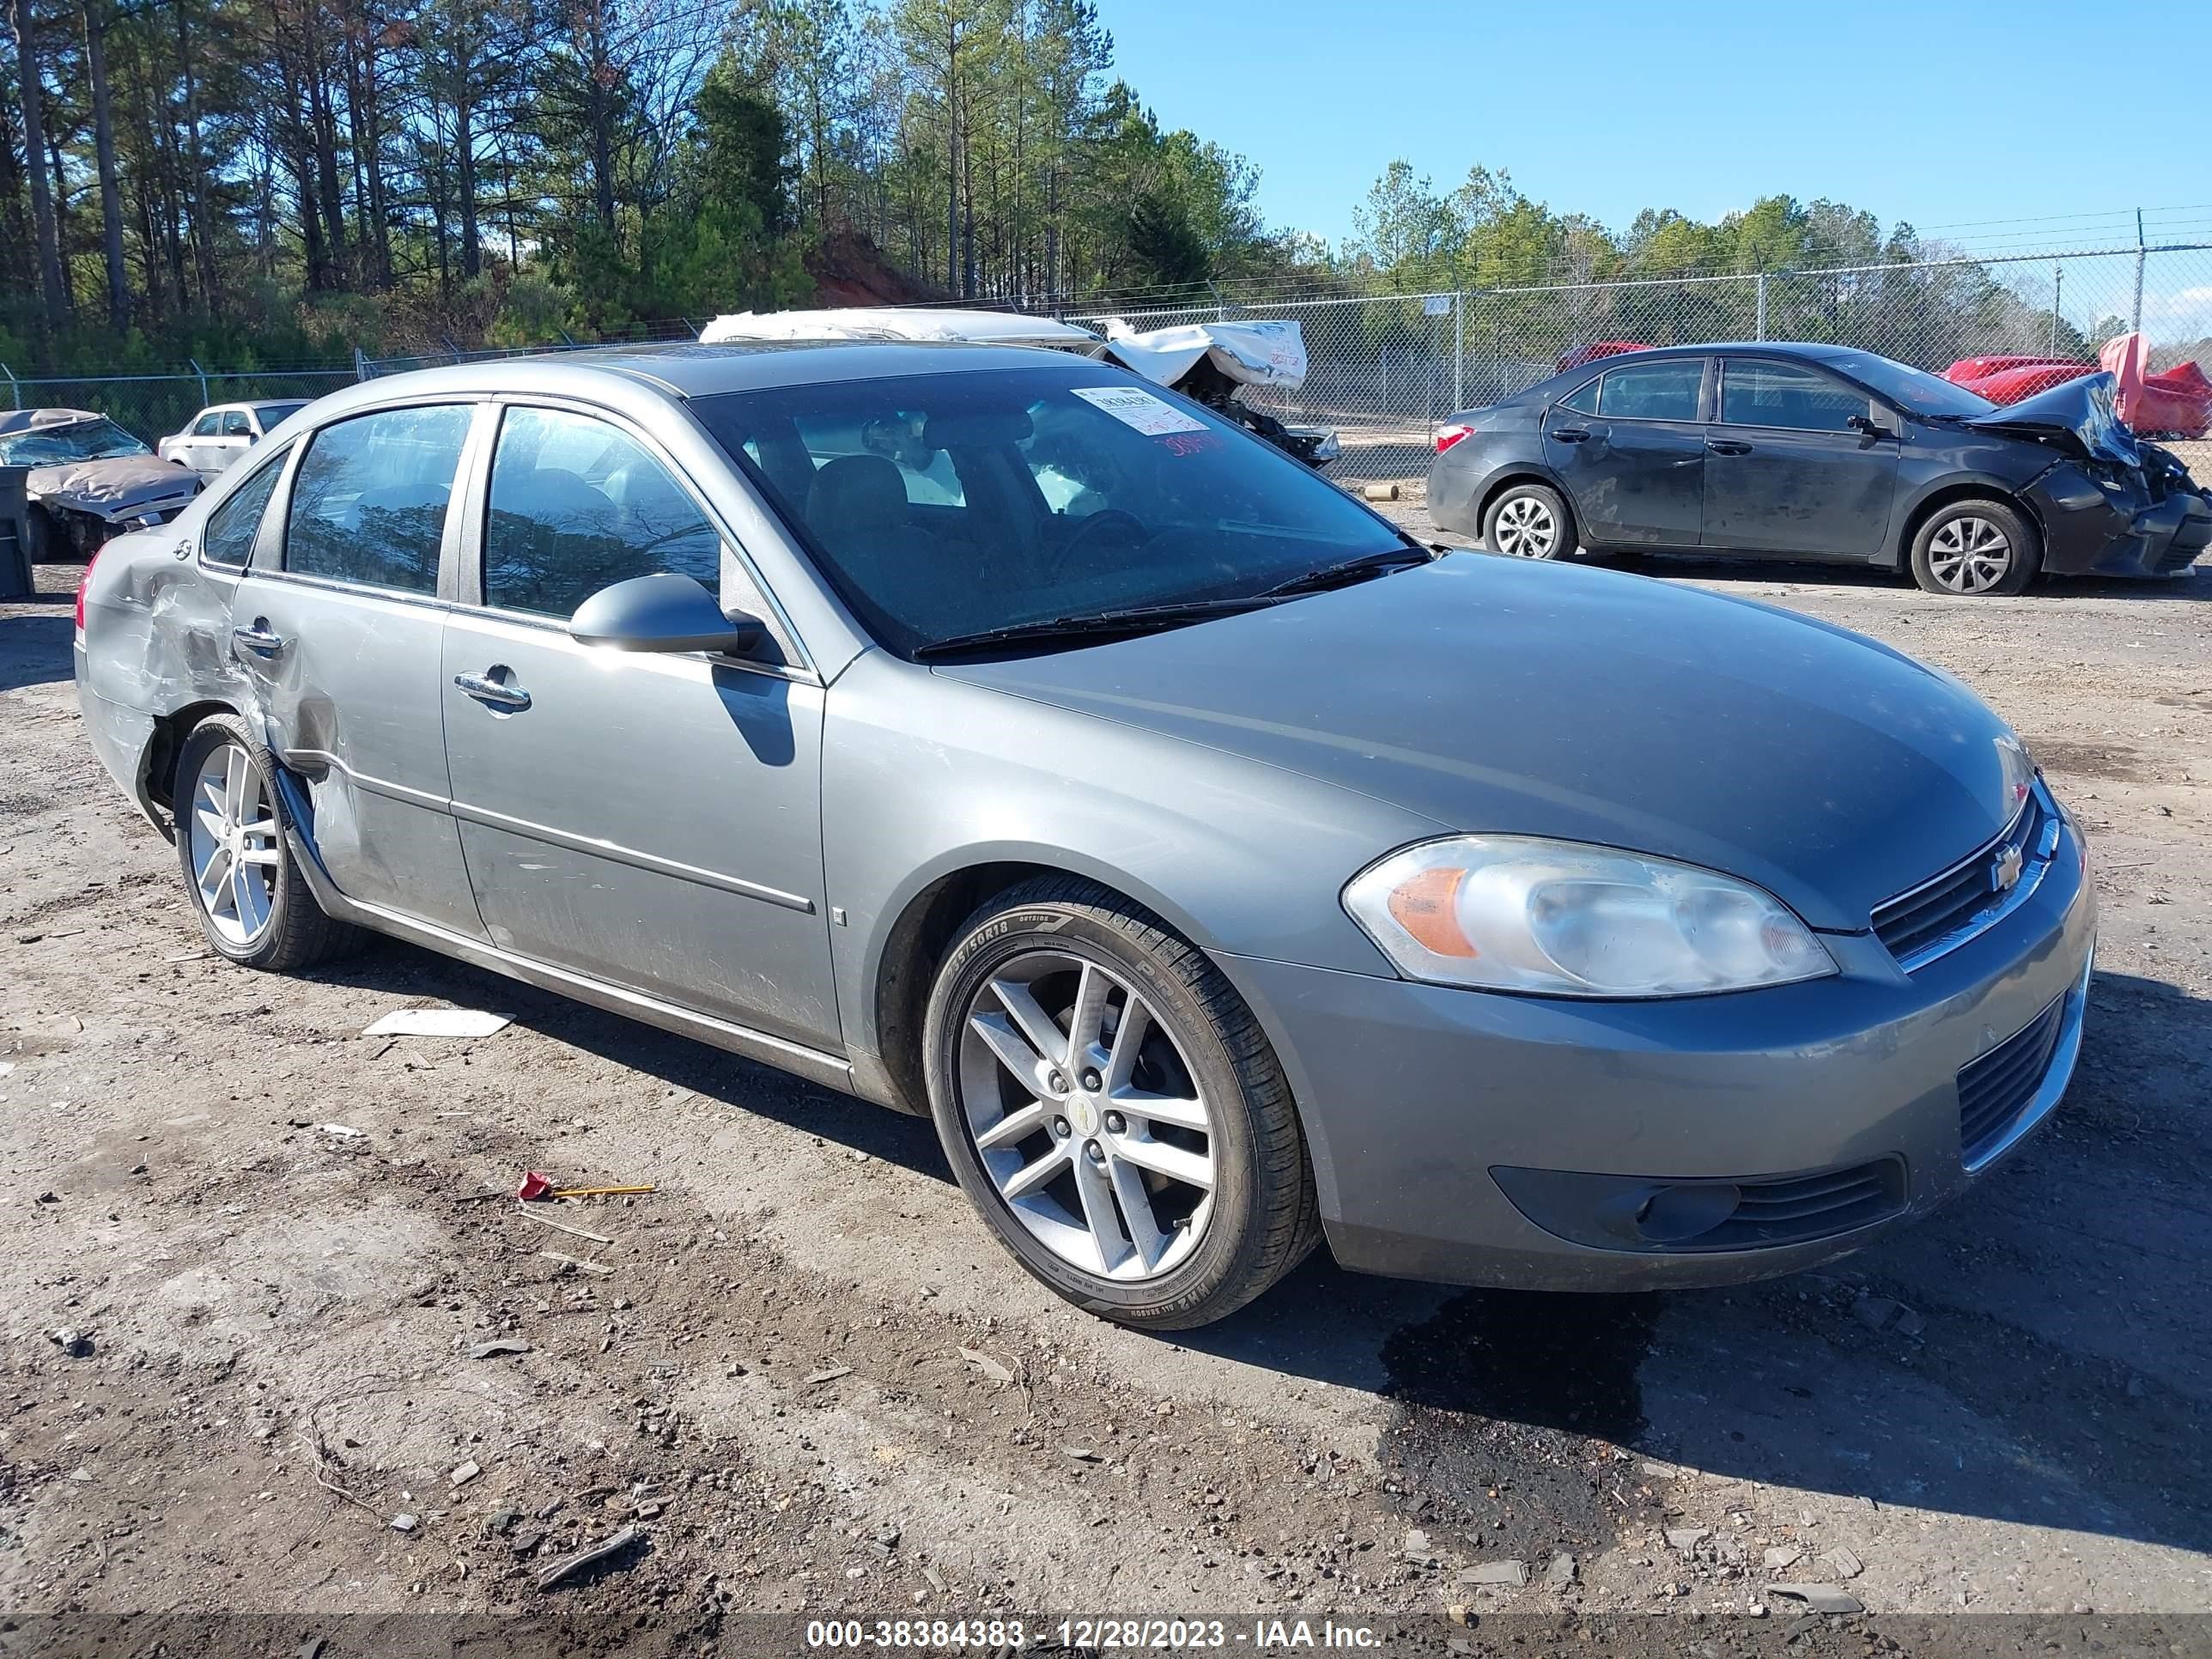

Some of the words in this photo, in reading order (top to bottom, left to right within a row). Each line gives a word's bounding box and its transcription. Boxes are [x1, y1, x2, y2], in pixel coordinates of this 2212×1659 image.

[1097, 396, 1157, 409] 38384383
[947, 921, 1008, 981] 235/50R18
[1130, 1309, 1160, 1317] SEASON
